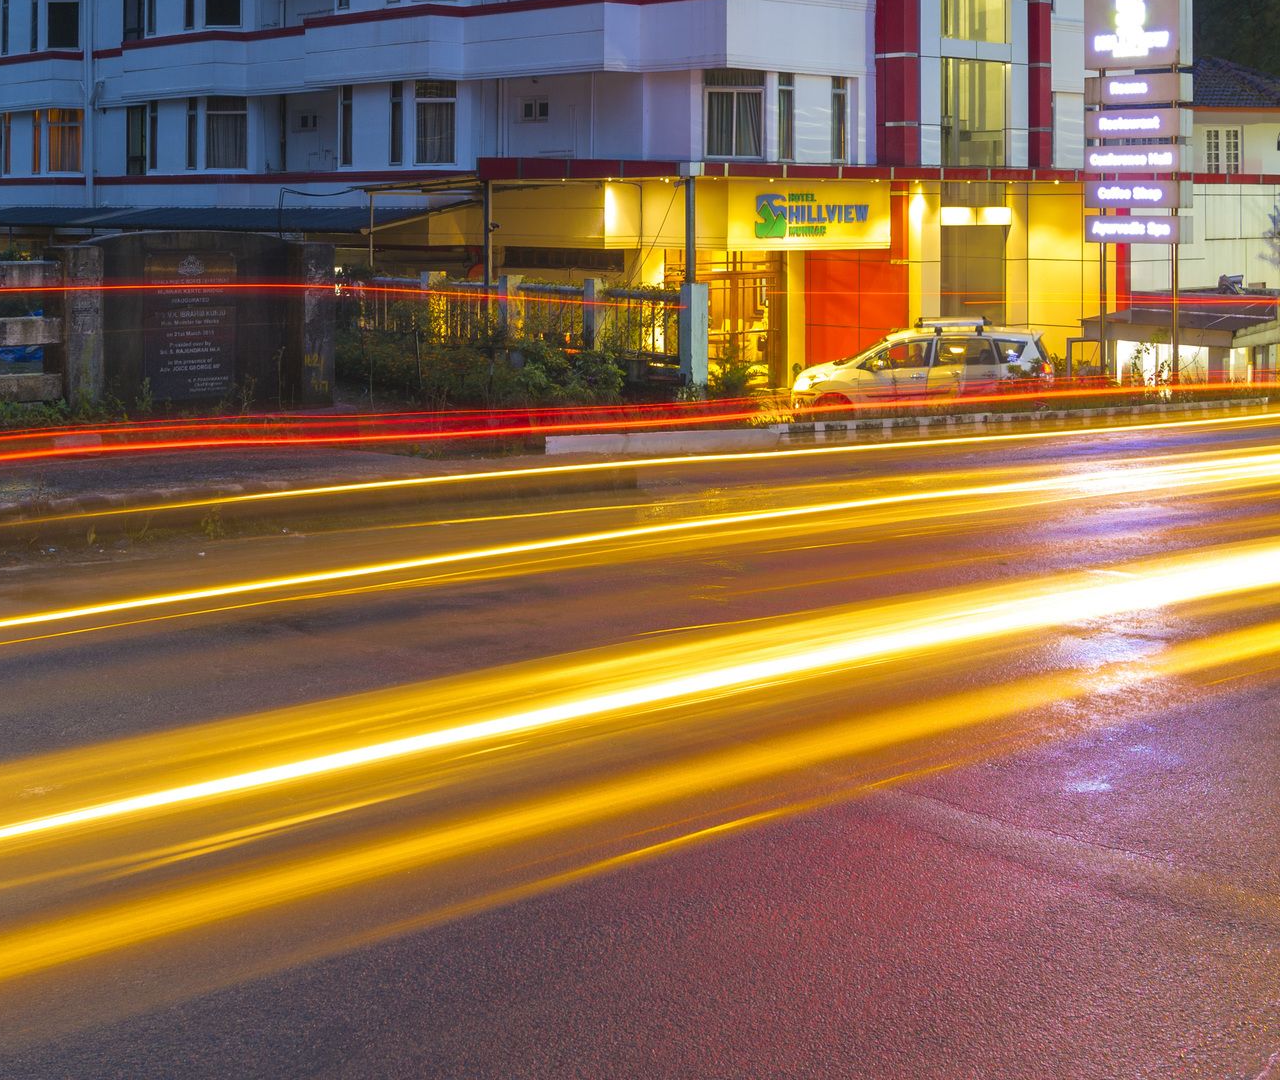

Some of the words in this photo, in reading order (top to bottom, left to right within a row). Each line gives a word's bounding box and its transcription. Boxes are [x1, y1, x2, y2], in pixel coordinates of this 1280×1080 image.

[788, 193, 817, 202] HOTEL
[788, 204, 869, 224] HILLVIEW
[788, 225, 827, 237] MUNNAR
